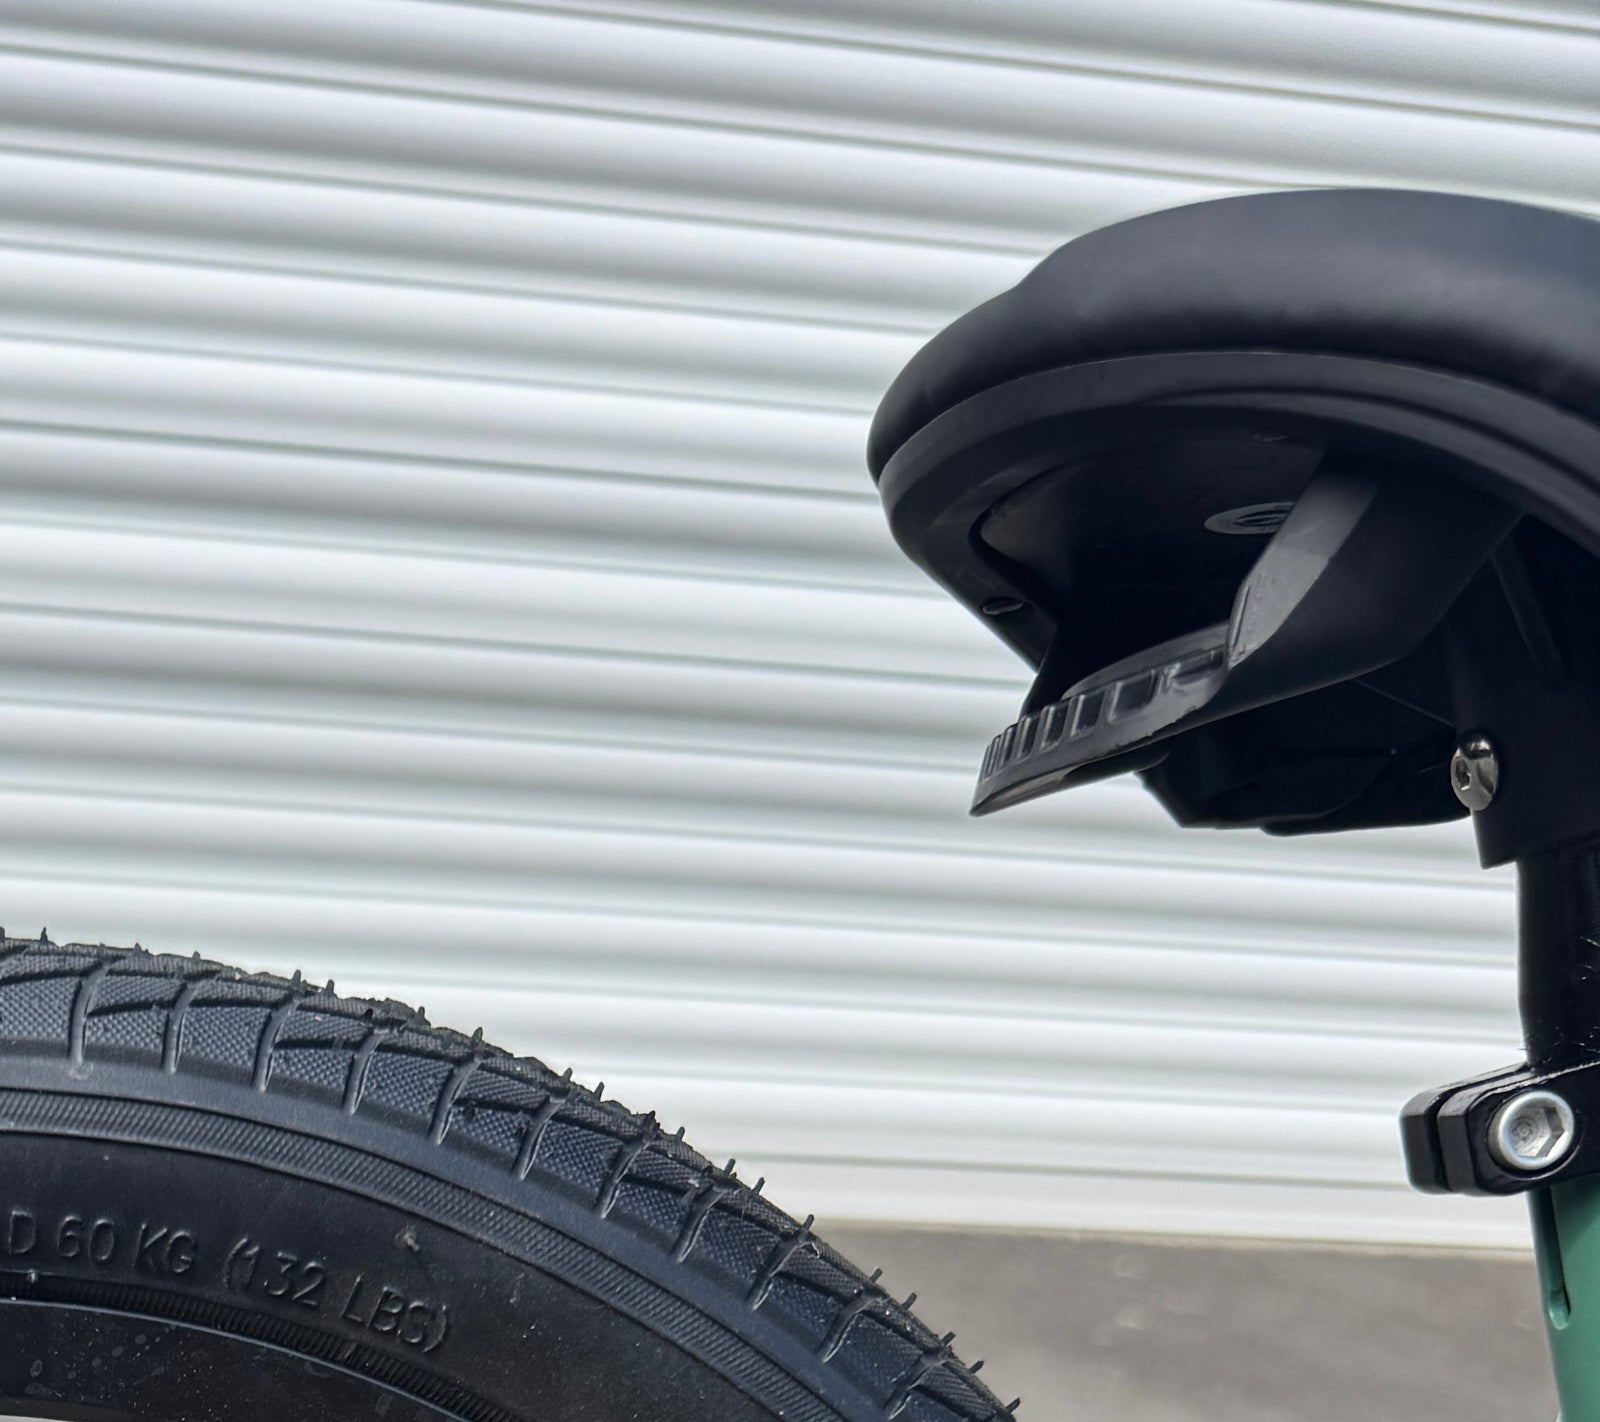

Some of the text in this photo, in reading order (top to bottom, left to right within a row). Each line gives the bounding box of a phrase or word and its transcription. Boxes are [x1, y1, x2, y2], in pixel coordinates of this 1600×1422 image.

[133, 1221, 199, 1274] KG
[223, 1235, 326, 1308] (132
[340, 1272, 448, 1354] LBS)
